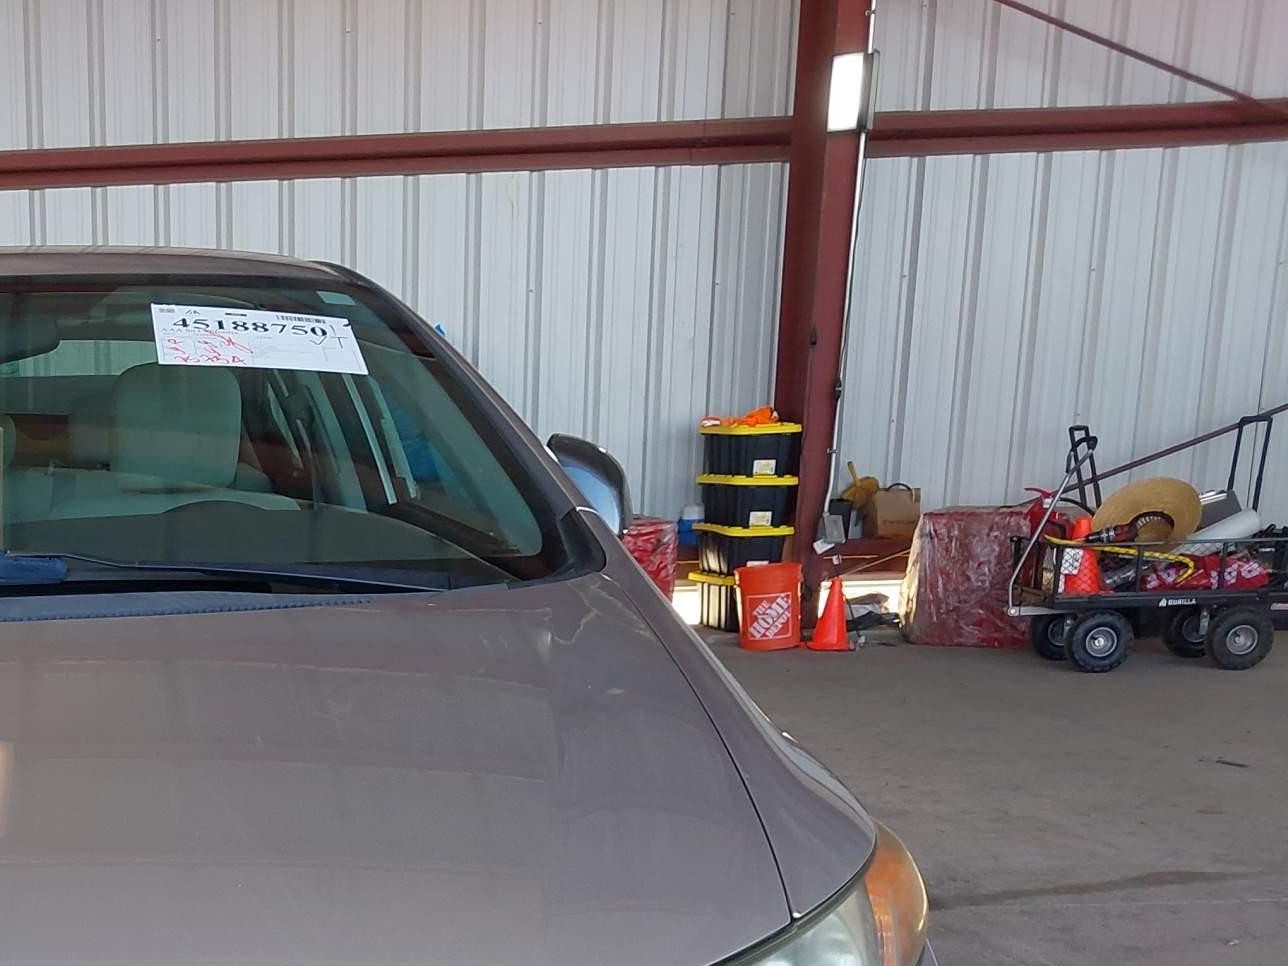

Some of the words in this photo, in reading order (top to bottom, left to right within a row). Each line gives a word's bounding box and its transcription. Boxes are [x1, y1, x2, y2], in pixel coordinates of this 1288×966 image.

[173, 317, 328, 337] 45188750
[750, 594, 790, 639] HOME
[752, 600, 772, 616] THE
[765, 610, 792, 639] DEPOT
